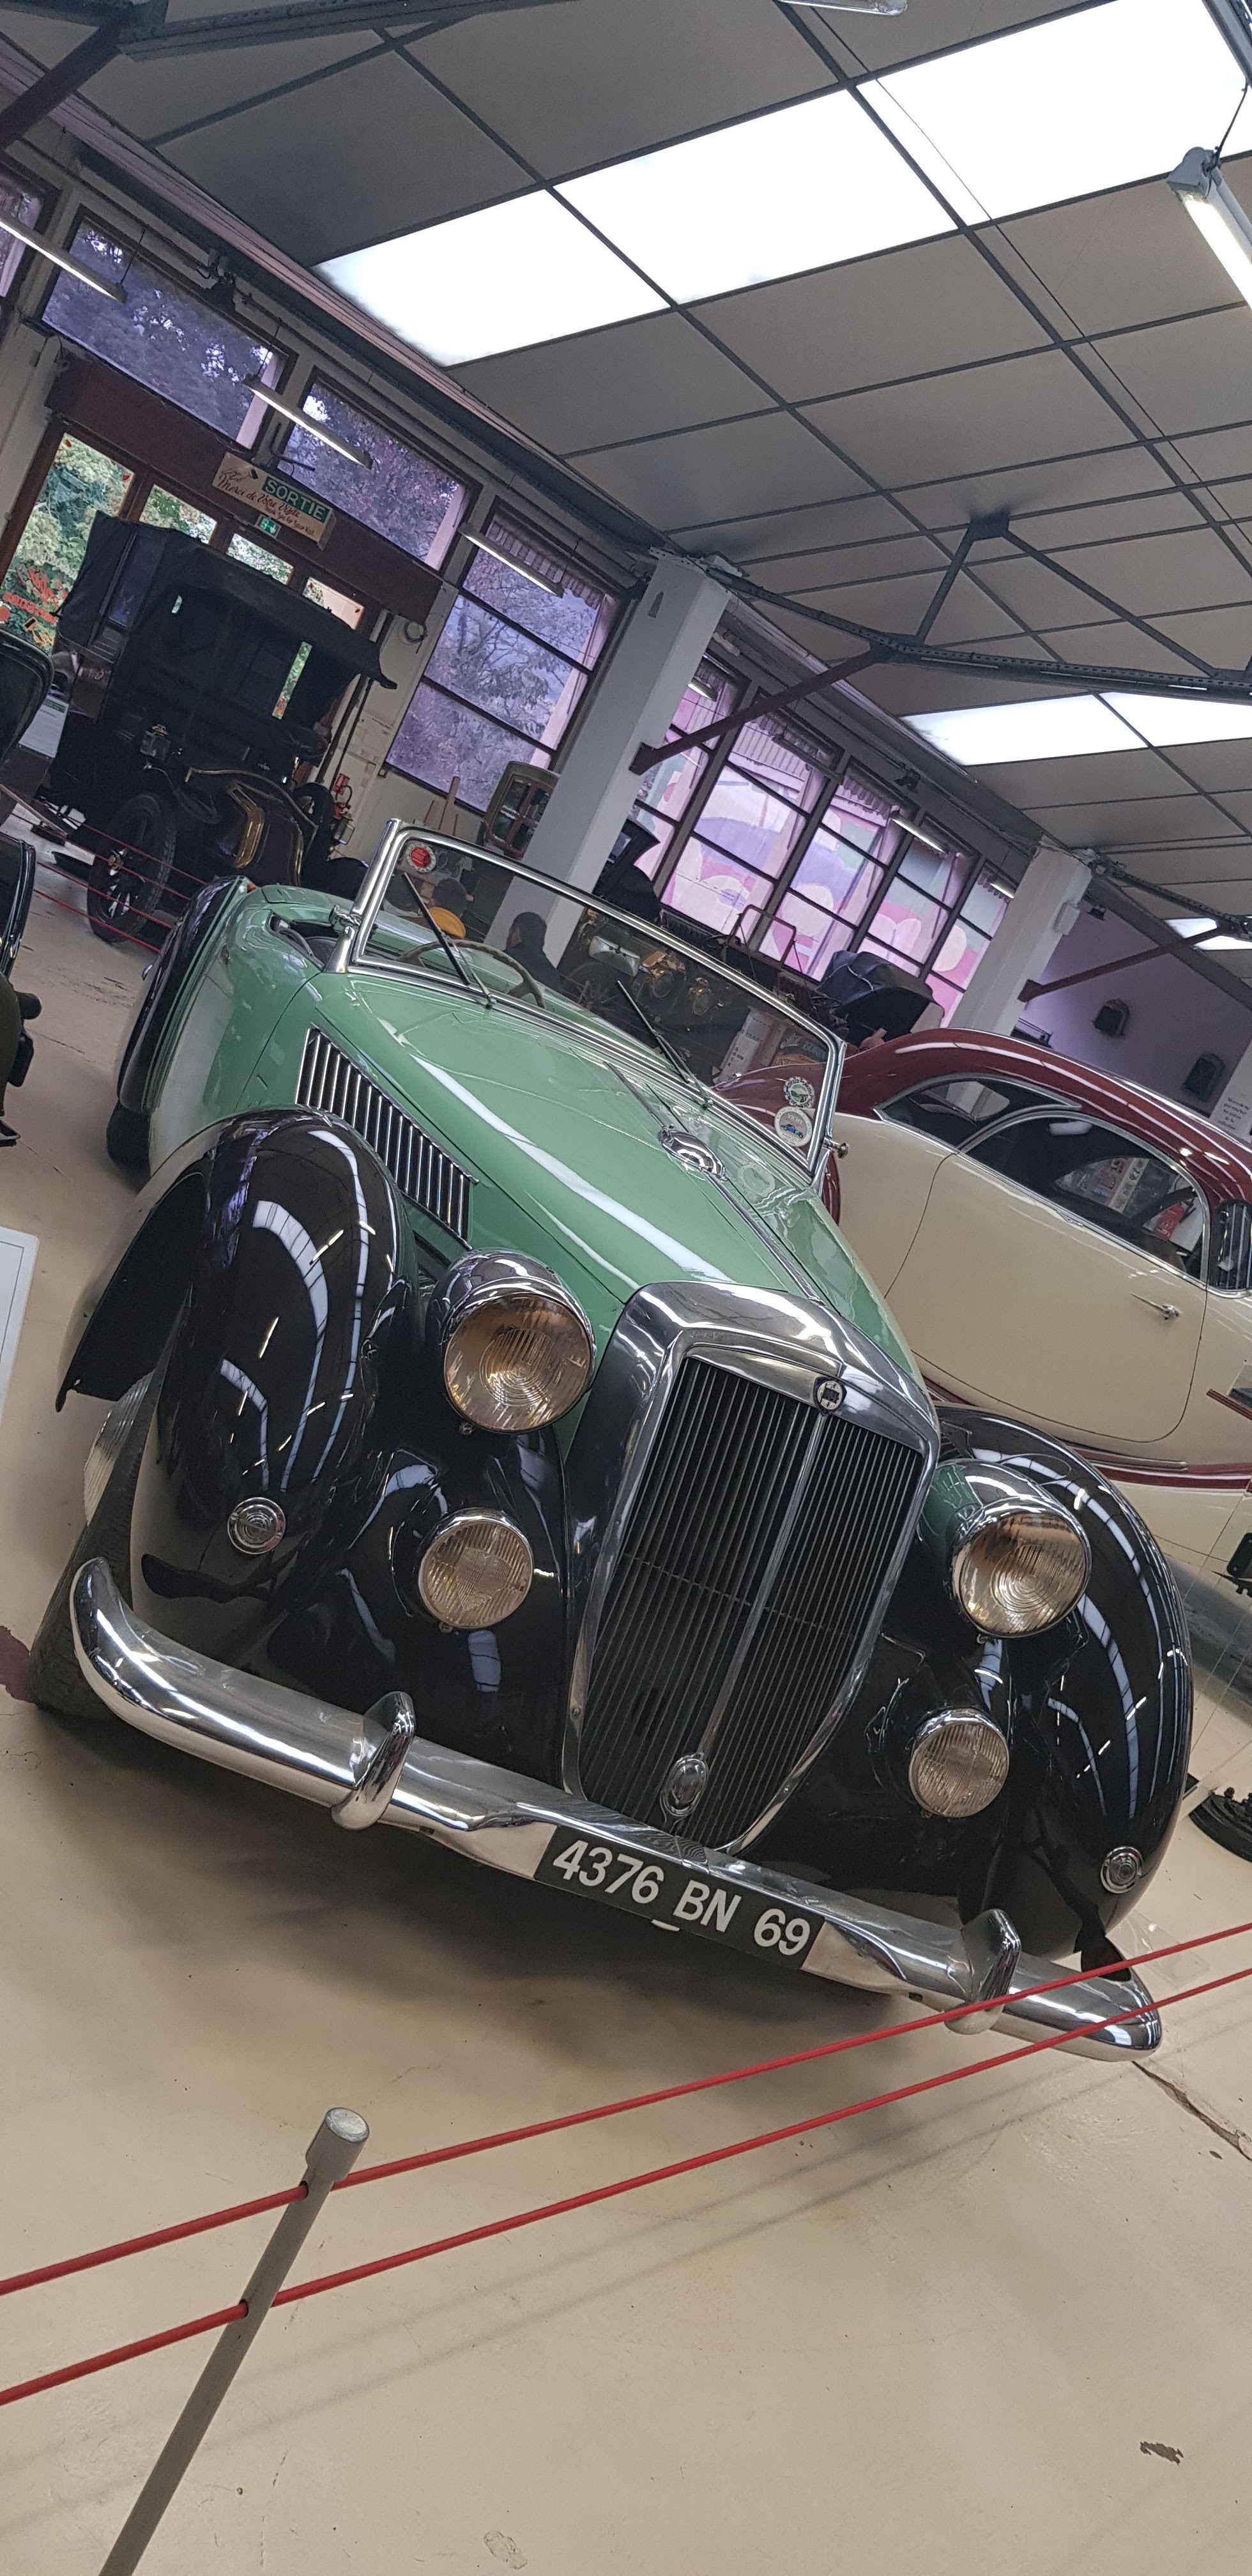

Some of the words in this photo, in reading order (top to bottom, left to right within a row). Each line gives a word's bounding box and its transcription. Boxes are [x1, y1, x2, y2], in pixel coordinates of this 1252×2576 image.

[217, 475, 244, 496] Merci
[246, 491, 256, 501] de
[265, 479, 326, 520] SORTIE
[553, 1840, 664, 1904] 4376
[673, 1880, 742, 1933] BN
[754, 1908, 810, 1956] 69
